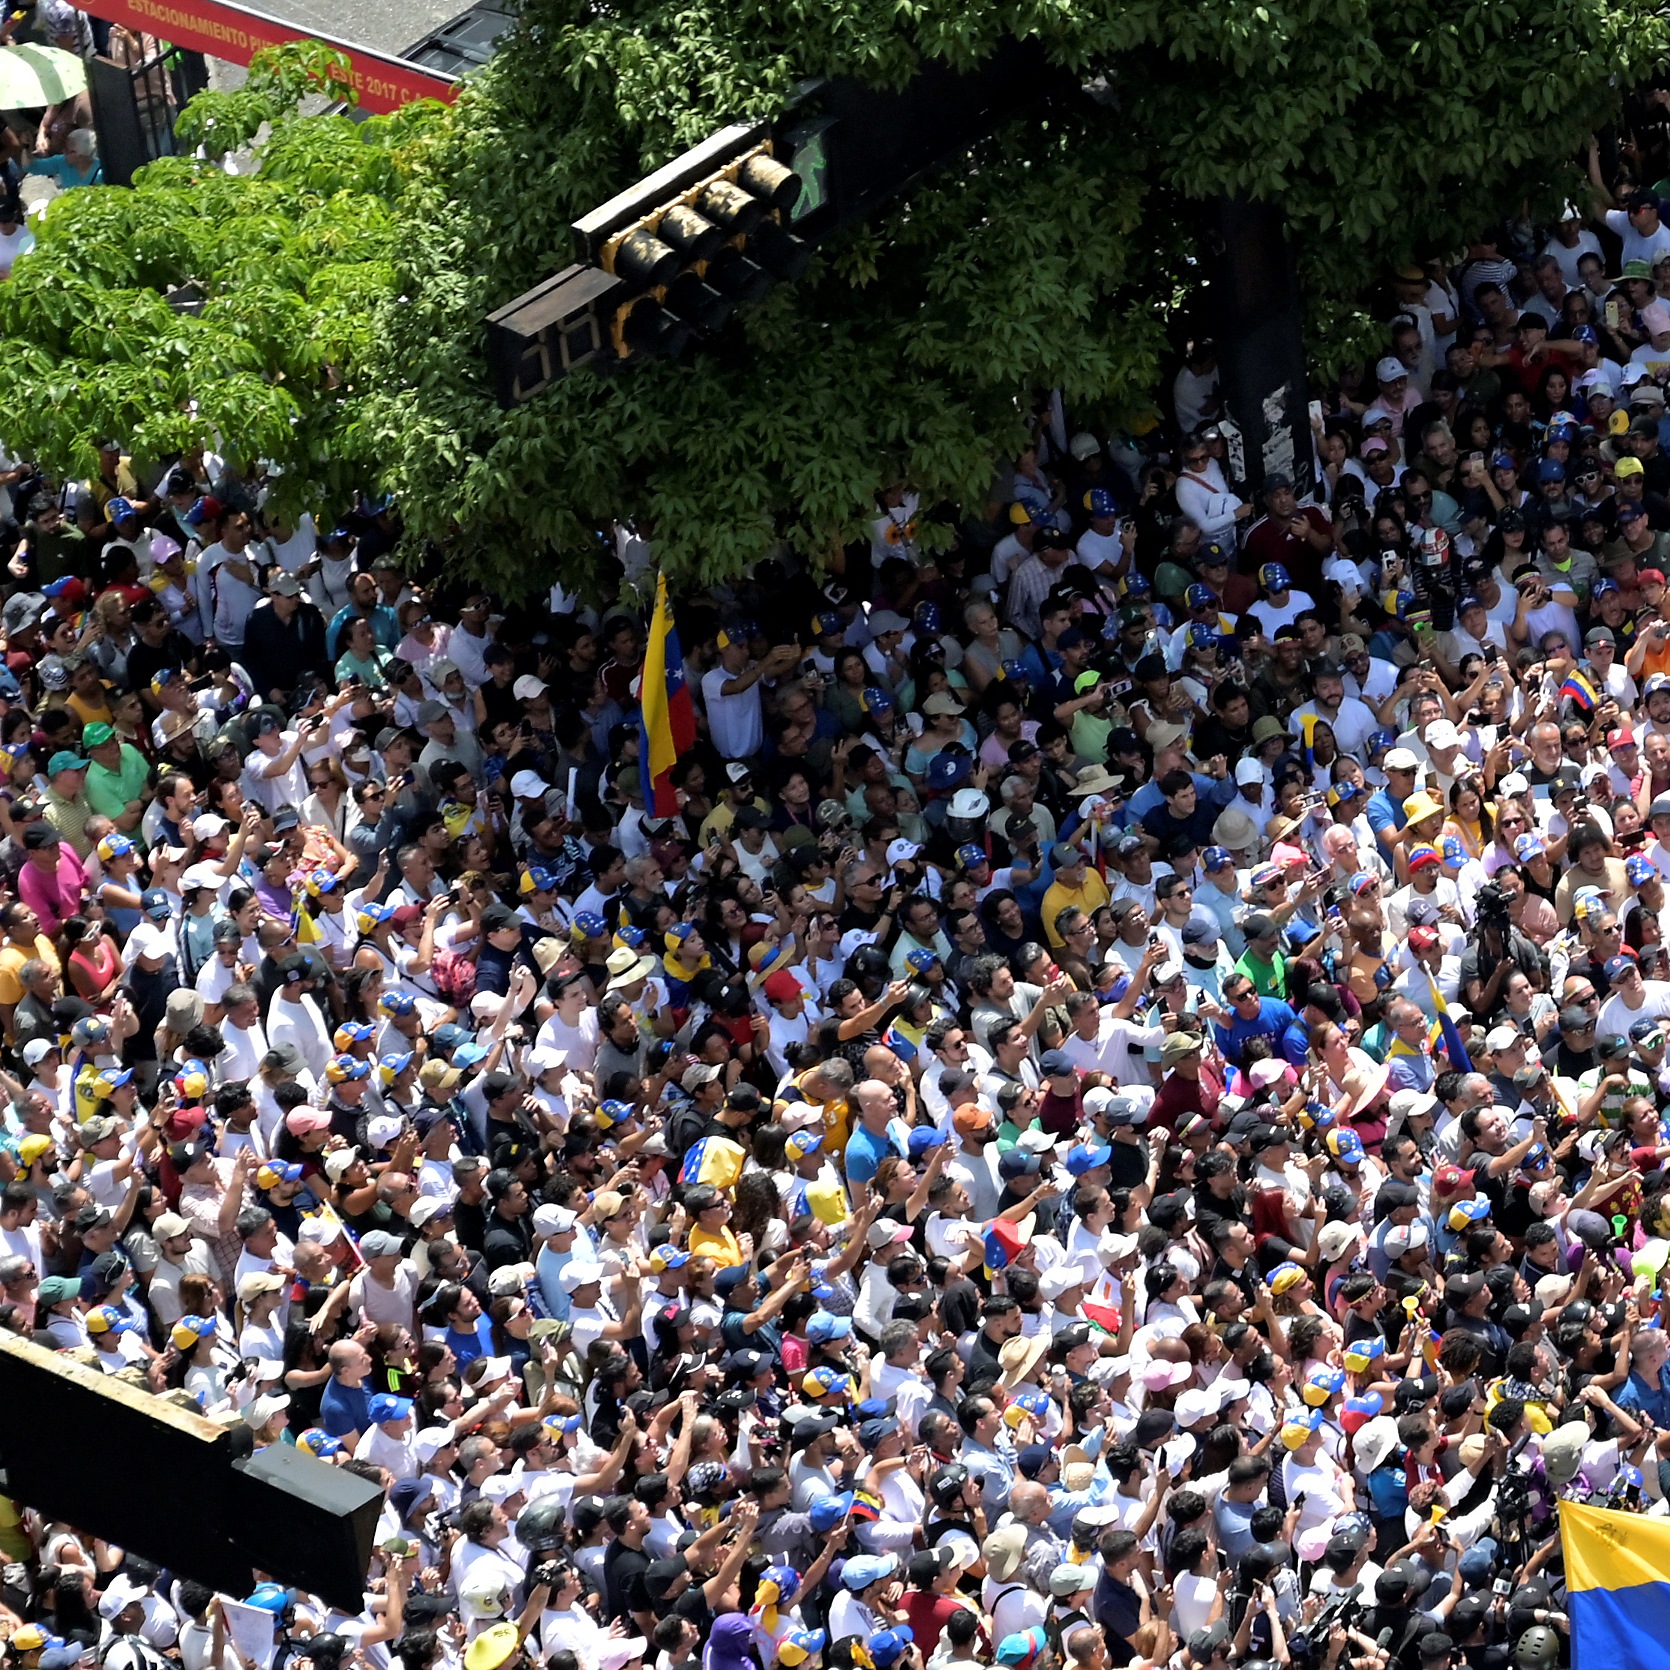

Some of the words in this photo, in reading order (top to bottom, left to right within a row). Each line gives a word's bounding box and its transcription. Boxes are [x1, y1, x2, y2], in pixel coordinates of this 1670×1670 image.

[129, 0, 248, 46] ESTACIONAMIENTO
[330, 62, 364, 91] ESTE
[366, 77, 398, 97] 2017
